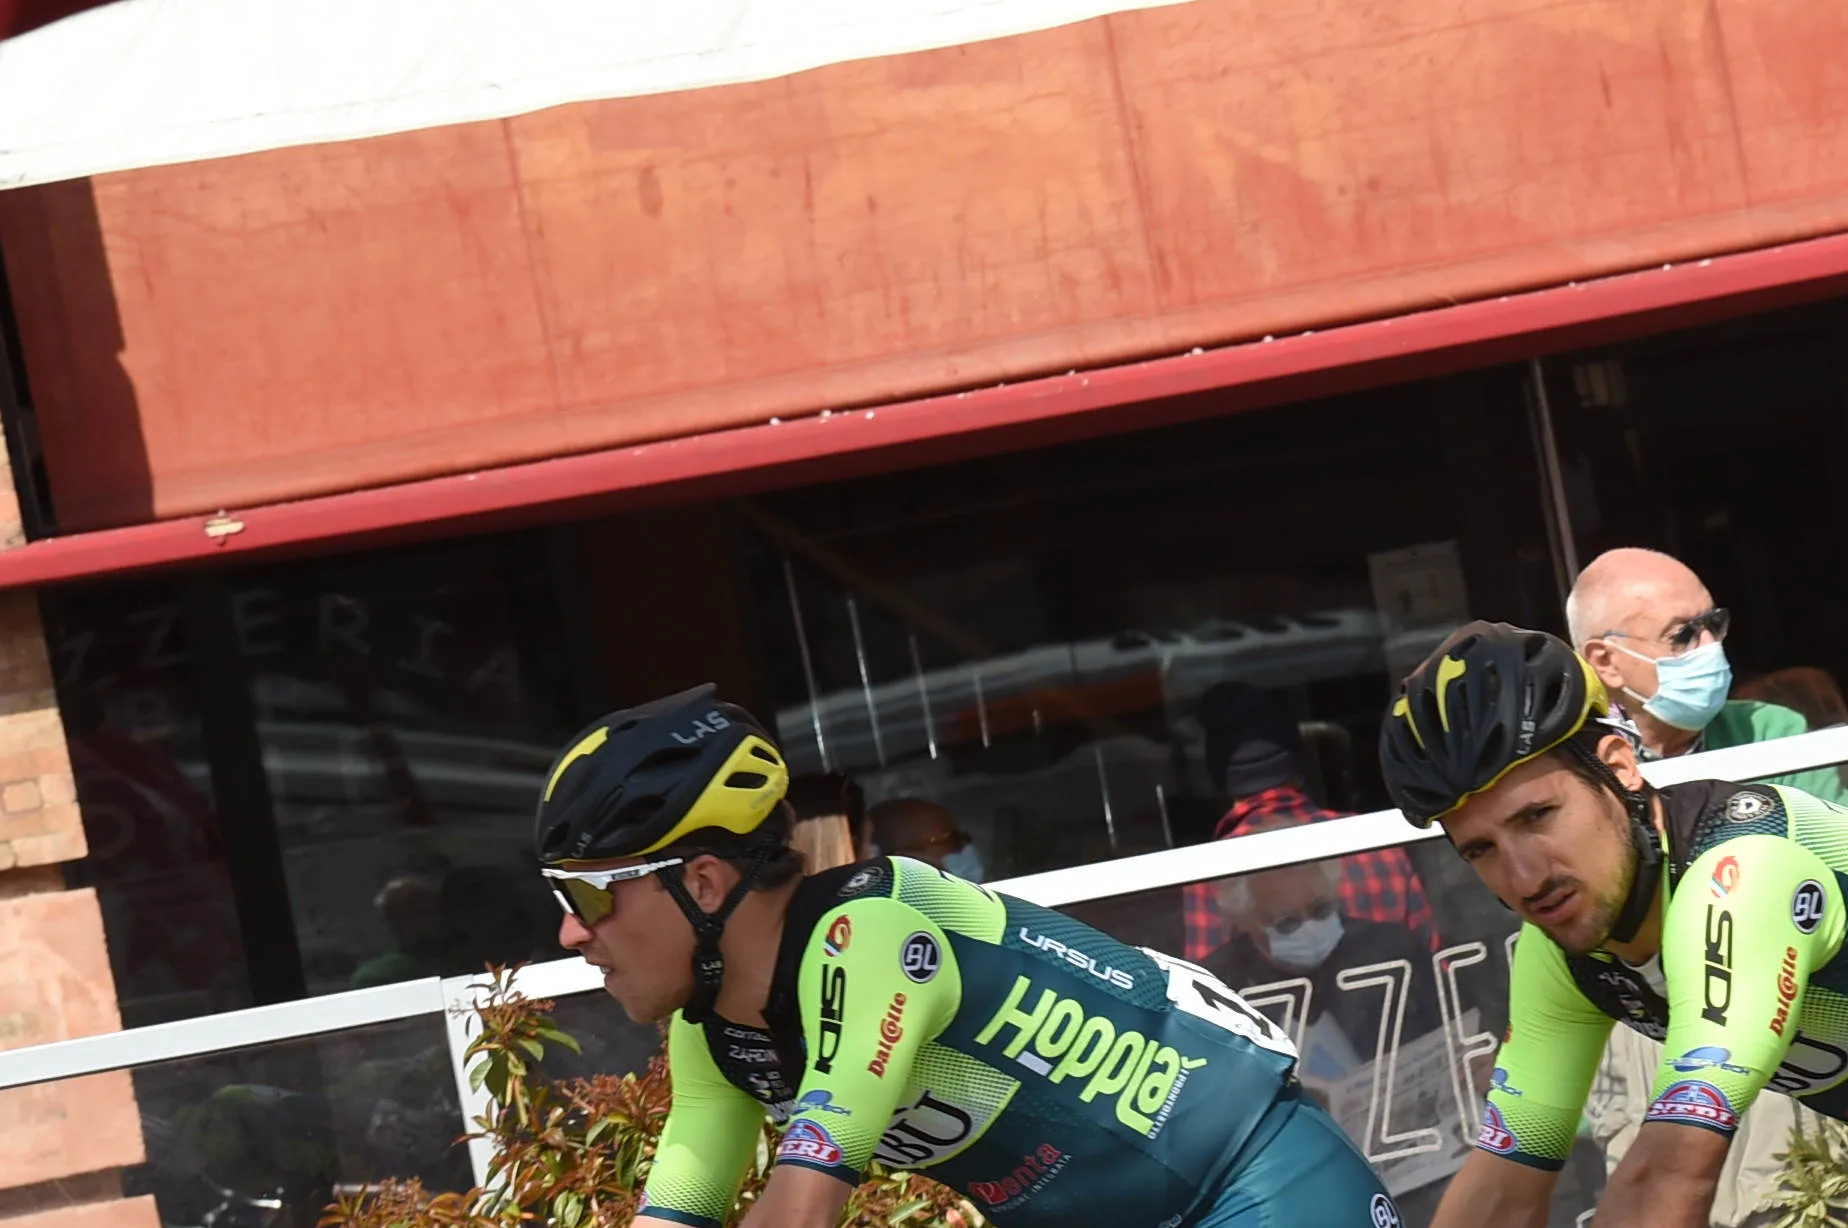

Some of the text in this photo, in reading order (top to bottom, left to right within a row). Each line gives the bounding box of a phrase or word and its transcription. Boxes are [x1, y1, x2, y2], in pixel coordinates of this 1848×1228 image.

[670, 710, 731, 744] LAS
[1018, 926, 1134, 991] URSUS
[1701, 903, 1734, 1028] SIDI
[814, 964, 846, 1075] SIDI
[782, 1140, 831, 1160] ERI
